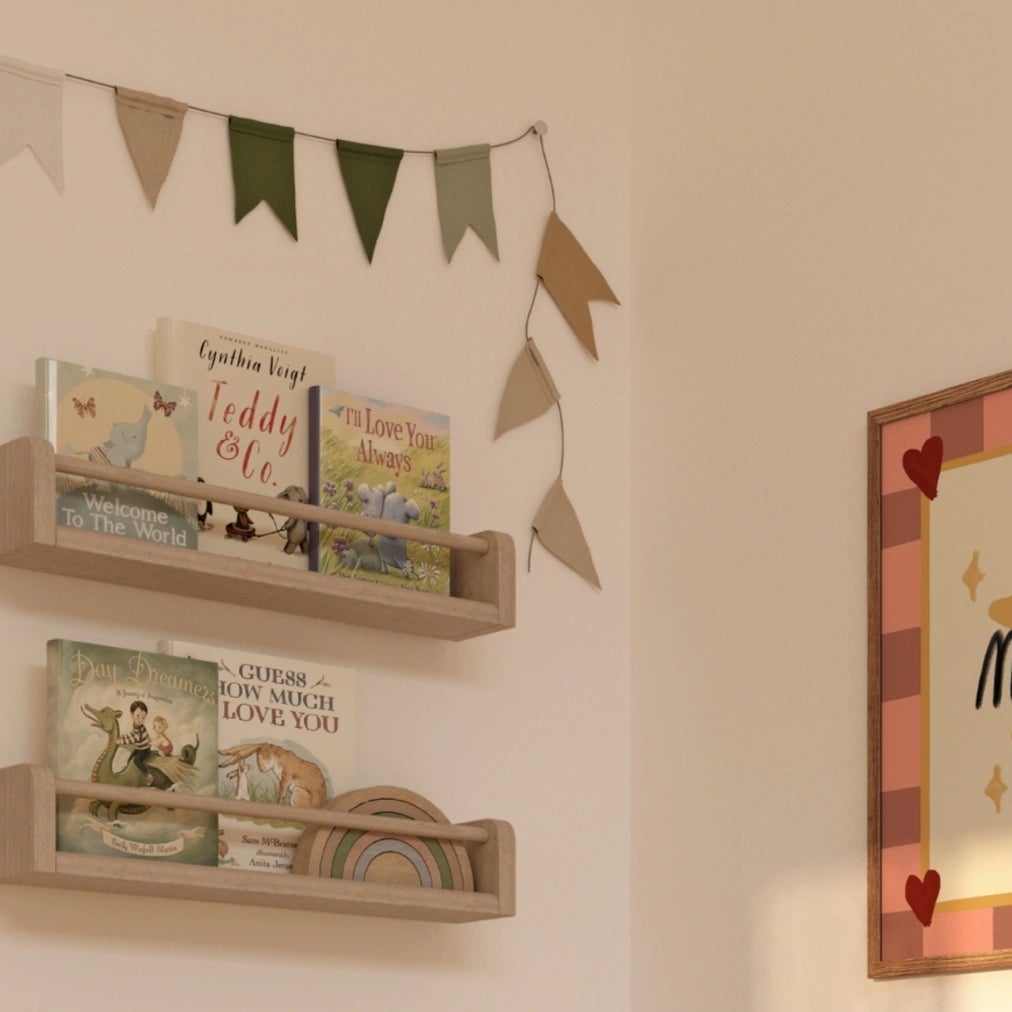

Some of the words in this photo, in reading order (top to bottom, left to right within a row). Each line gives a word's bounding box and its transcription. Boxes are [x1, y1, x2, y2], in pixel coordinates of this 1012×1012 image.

[199, 339, 261, 371] Cynthia
[269, 355, 307, 390] Voigt
[208, 379, 298, 458] Teddy
[346, 407, 361, 428] I'll
[365, 407, 403, 441] Love
[406, 421, 435, 451] You
[357, 438, 412, 478] Always
[61, 507, 84, 528] To
[89, 512, 126, 536] The
[131, 520, 188, 547] World
[83, 492, 169, 525] Welcome
[69, 649, 117, 688] Day
[126, 650, 217, 706] Dreamers
[238, 663, 307, 688] GUESS
[222, 700, 286, 727] LOVE
[290, 710, 339, 734] YOU
[269, 687, 335, 712] MUCH
